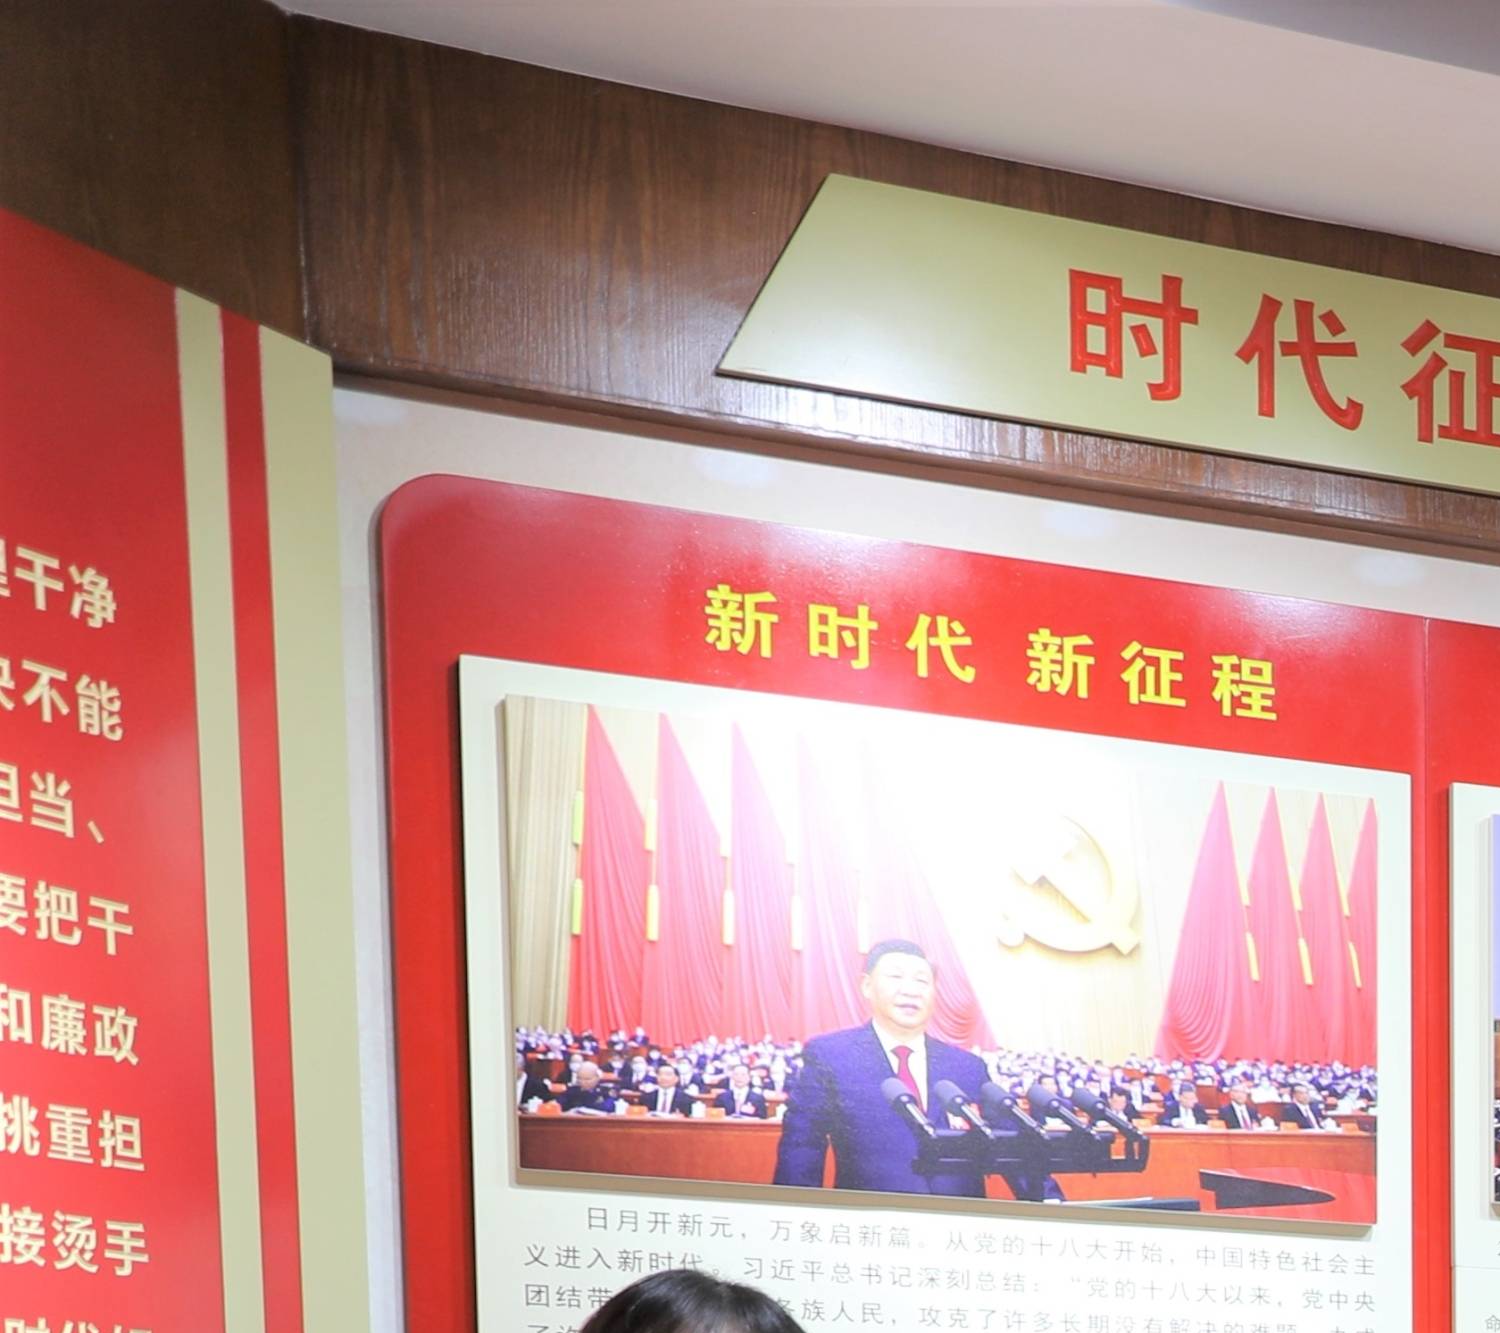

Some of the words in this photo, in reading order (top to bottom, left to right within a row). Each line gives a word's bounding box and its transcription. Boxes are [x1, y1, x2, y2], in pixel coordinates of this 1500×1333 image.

[0, 536, 117, 629] 干净
[703, 583, 977, 685] 新时代
[1025, 626, 1280, 723] 新征程
[0, 1204, 149, 1280] 接烫手
